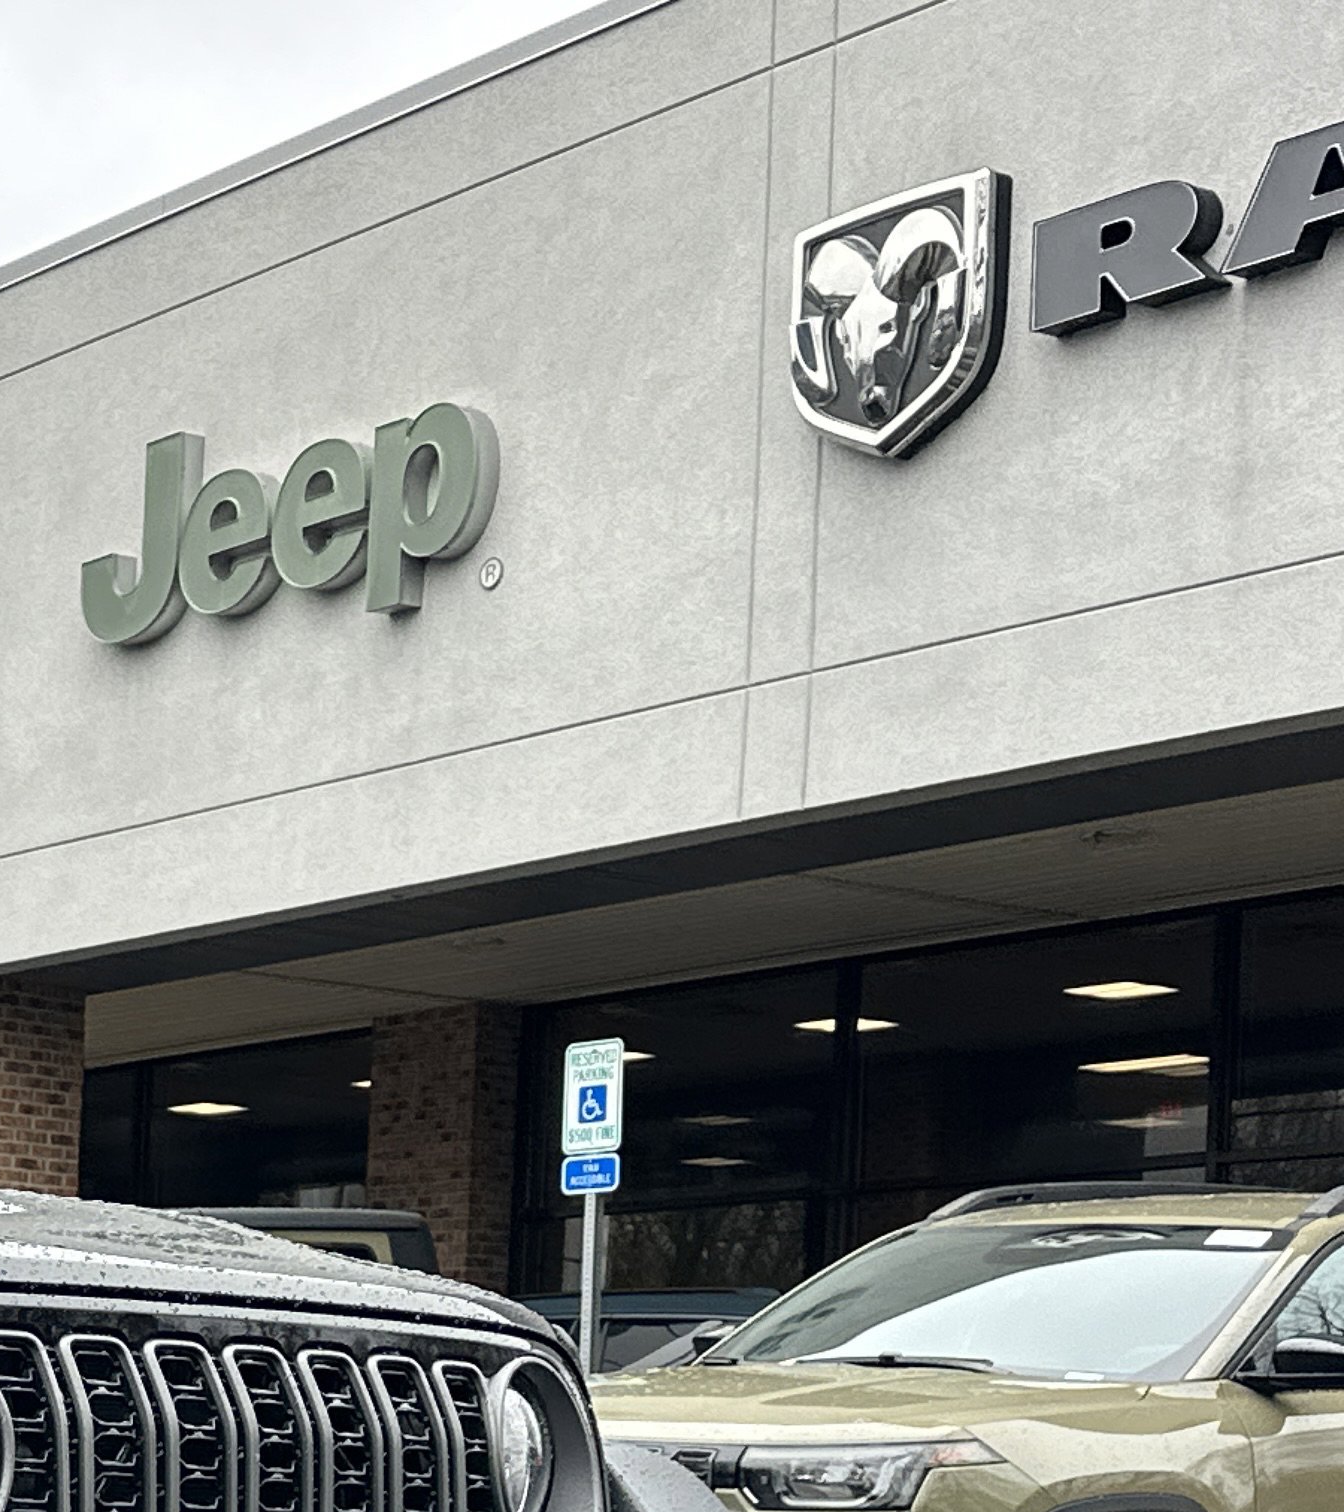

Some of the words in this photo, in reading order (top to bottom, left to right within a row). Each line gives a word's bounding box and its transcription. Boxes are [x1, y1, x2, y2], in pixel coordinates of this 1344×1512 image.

[81, 402, 500, 646] Jeep
[571, 1049, 617, 1067] RESERVED
[573, 1066, 615, 1082] PARKING
[595, 1125, 615, 1142] FINE
